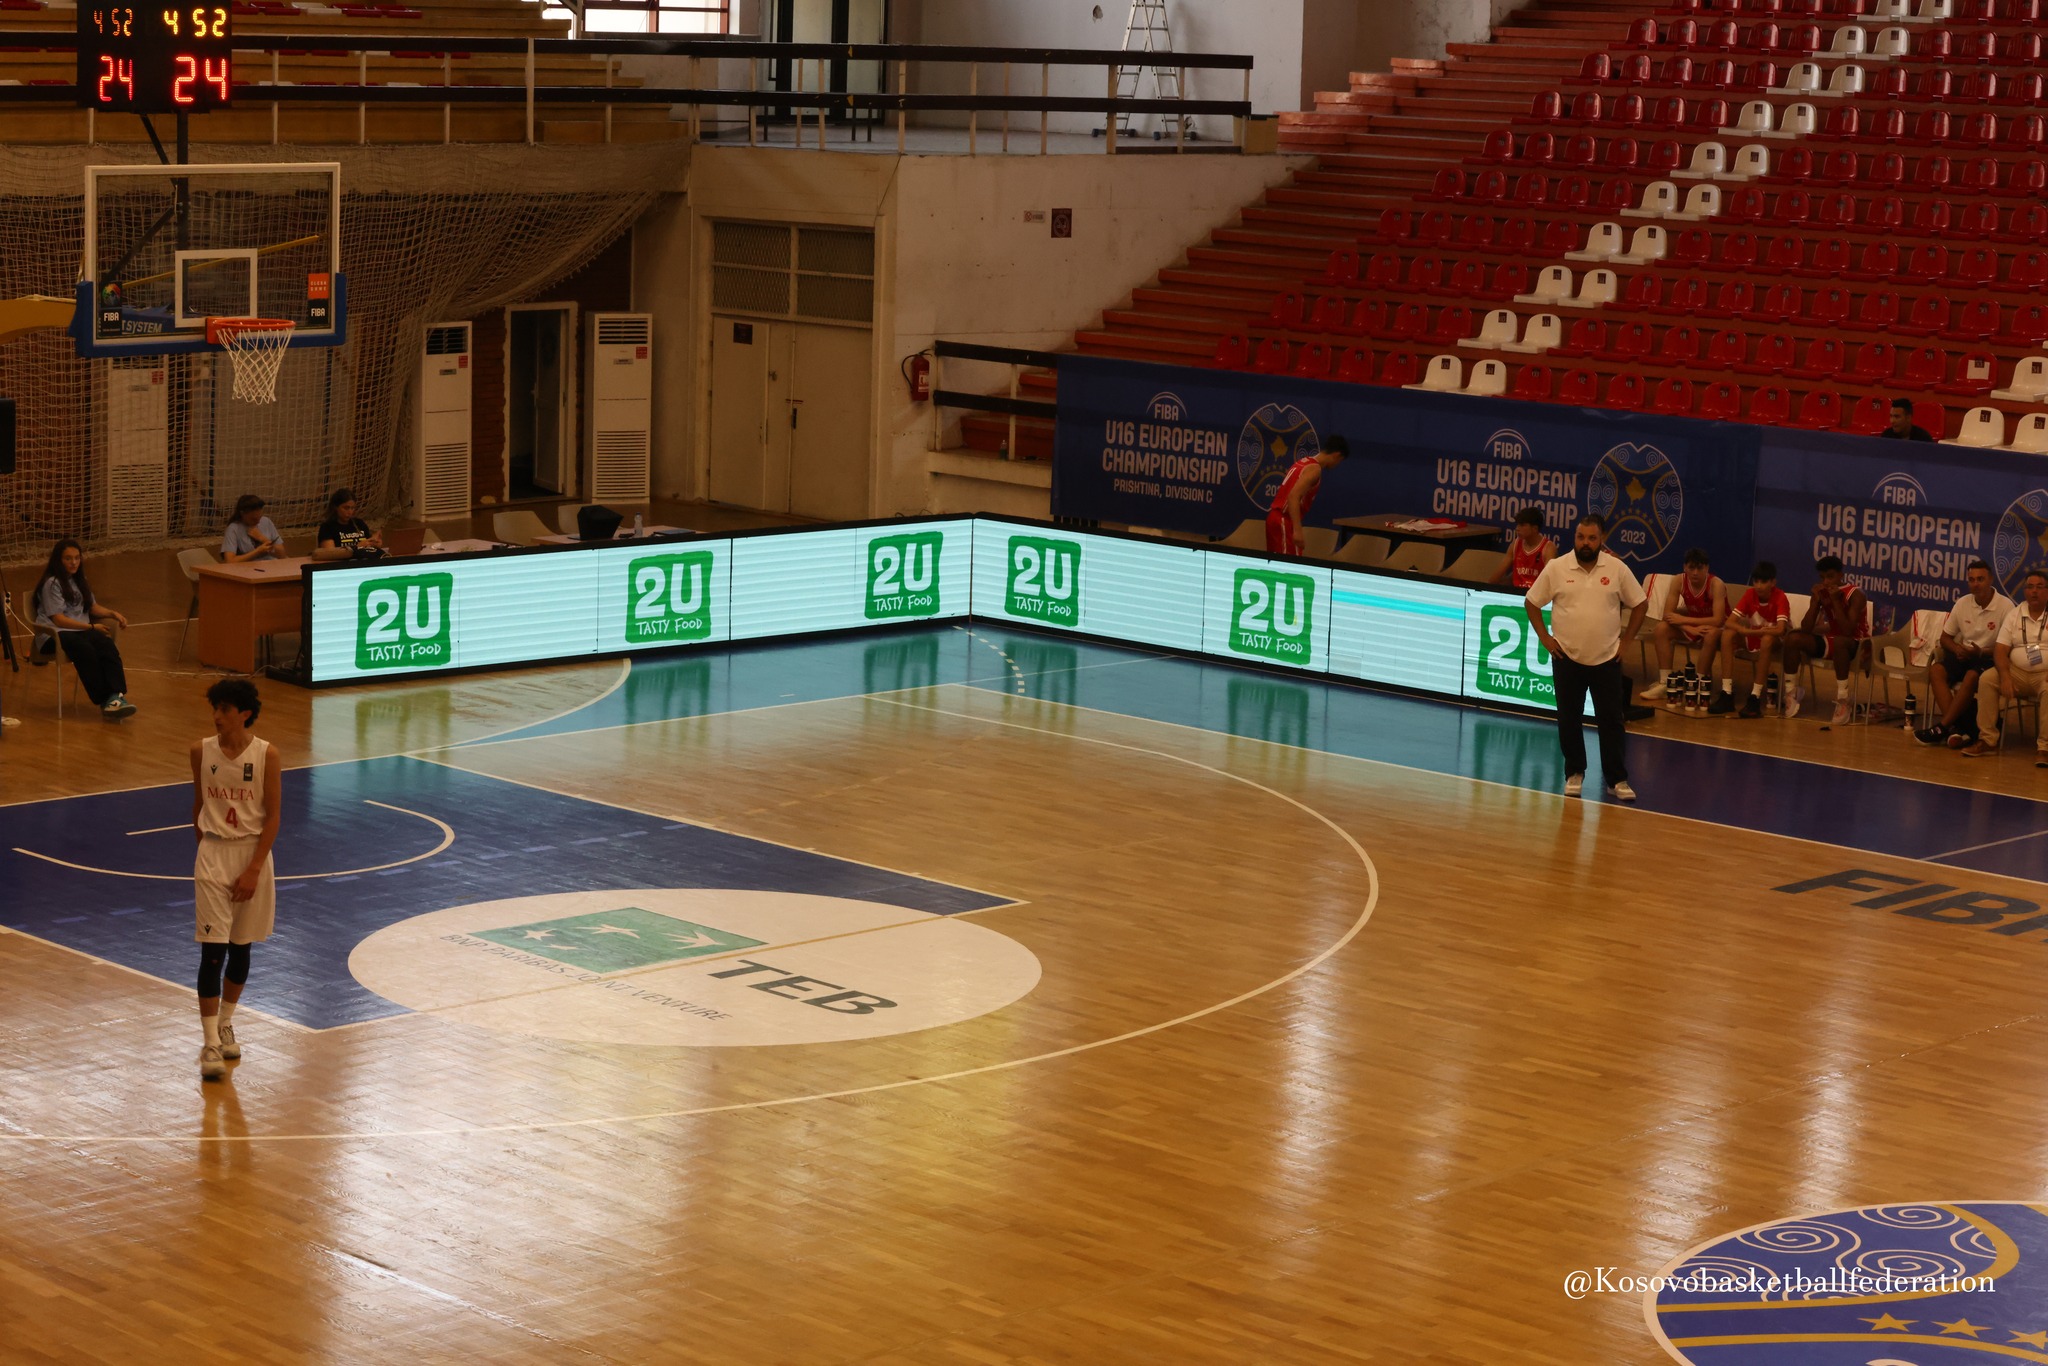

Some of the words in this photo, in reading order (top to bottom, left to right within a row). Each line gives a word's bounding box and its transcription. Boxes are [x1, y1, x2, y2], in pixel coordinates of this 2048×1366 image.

[192, 8, 227, 38] 52
[98, 54, 134, 102] 24
[173, 55, 228, 103] 24
[103, 311, 120, 322] FIBA
[310, 307, 326, 317] FIBA
[126, 320, 163, 335] SYSTEM
[1153, 402, 1179, 421] FIBA
[1105, 419, 1135, 447] U16
[1138, 423, 1229, 458] EUROPEAN
[1492, 440, 1523, 461] FIBA
[1102, 447, 1229, 486] CHAMPIONSHIP
[1436, 457, 1471, 487] U16
[1475, 462, 1578, 500] EUROPEAN
[1113, 478, 1163, 499] PRISHTINA,
[1165, 484, 1206, 504] DIVISION
[1205, 489, 1214, 504] C
[1882, 485, 1917, 507] FIBA
[1619, 529, 1647, 545] 2023
[1817, 502, 1857, 534] U16
[1861, 507, 1981, 551] EUROPEAN
[872, 542, 933, 597] 2U
[1013, 545, 1072, 601] 2U
[634, 562, 703, 620] 2U
[1896, 582, 1949, 602] DIVISION
[365, 585, 441, 645] 2U
[873, 596, 904, 612] TASTY
[1014, 596, 1044, 614] TASTY
[1238, 578, 1305, 637] 2U
[636, 619, 671, 636] TASTY
[1239, 632, 1273, 651] TASTY
[366, 644, 405, 662] TASTY
[1487, 671, 1525, 691] TASTY
[207, 786, 255, 801] MALTA
[226, 807, 239, 829] 4
[439, 933, 489, 956] BNP
[486, 946, 574, 977] PARIBAS
[565, 972, 634, 993] JOINT
[631, 989, 734, 1022] VENTURE
[707, 959, 898, 1015] TEB
